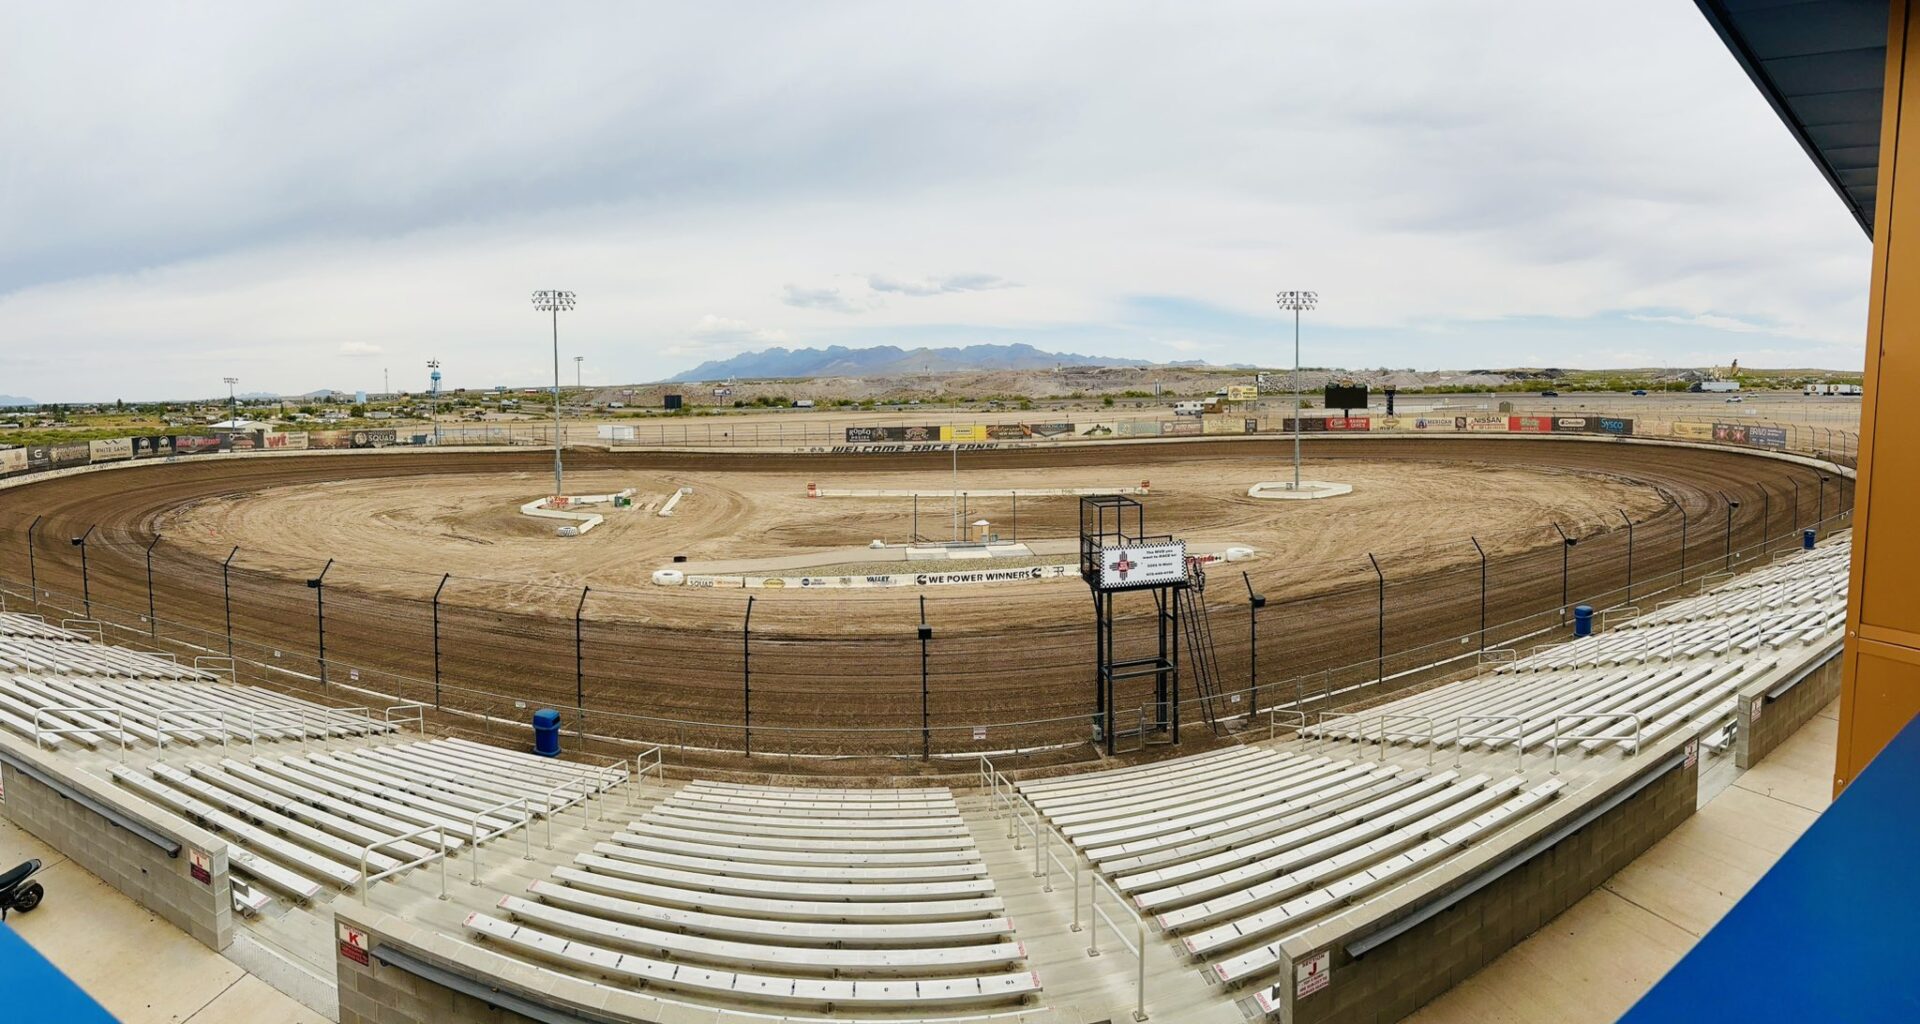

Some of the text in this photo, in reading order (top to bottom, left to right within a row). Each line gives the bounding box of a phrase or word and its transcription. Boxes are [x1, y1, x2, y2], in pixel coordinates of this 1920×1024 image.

[1474, 416, 1502, 424] NISSAN
[1600, 418, 1624, 430] Sysco
[114, 445, 131, 453] SANDS
[830, 444, 905, 454] WELCOME
[911, 444, 951, 452] RACE
[866, 575, 890, 583] VALLEY
[928, 570, 1030, 584] WE POWER WINNERS
[689, 580, 714, 588] SQUAD
[348, 931, 359, 946] K
[1308, 961, 1317, 976] J
